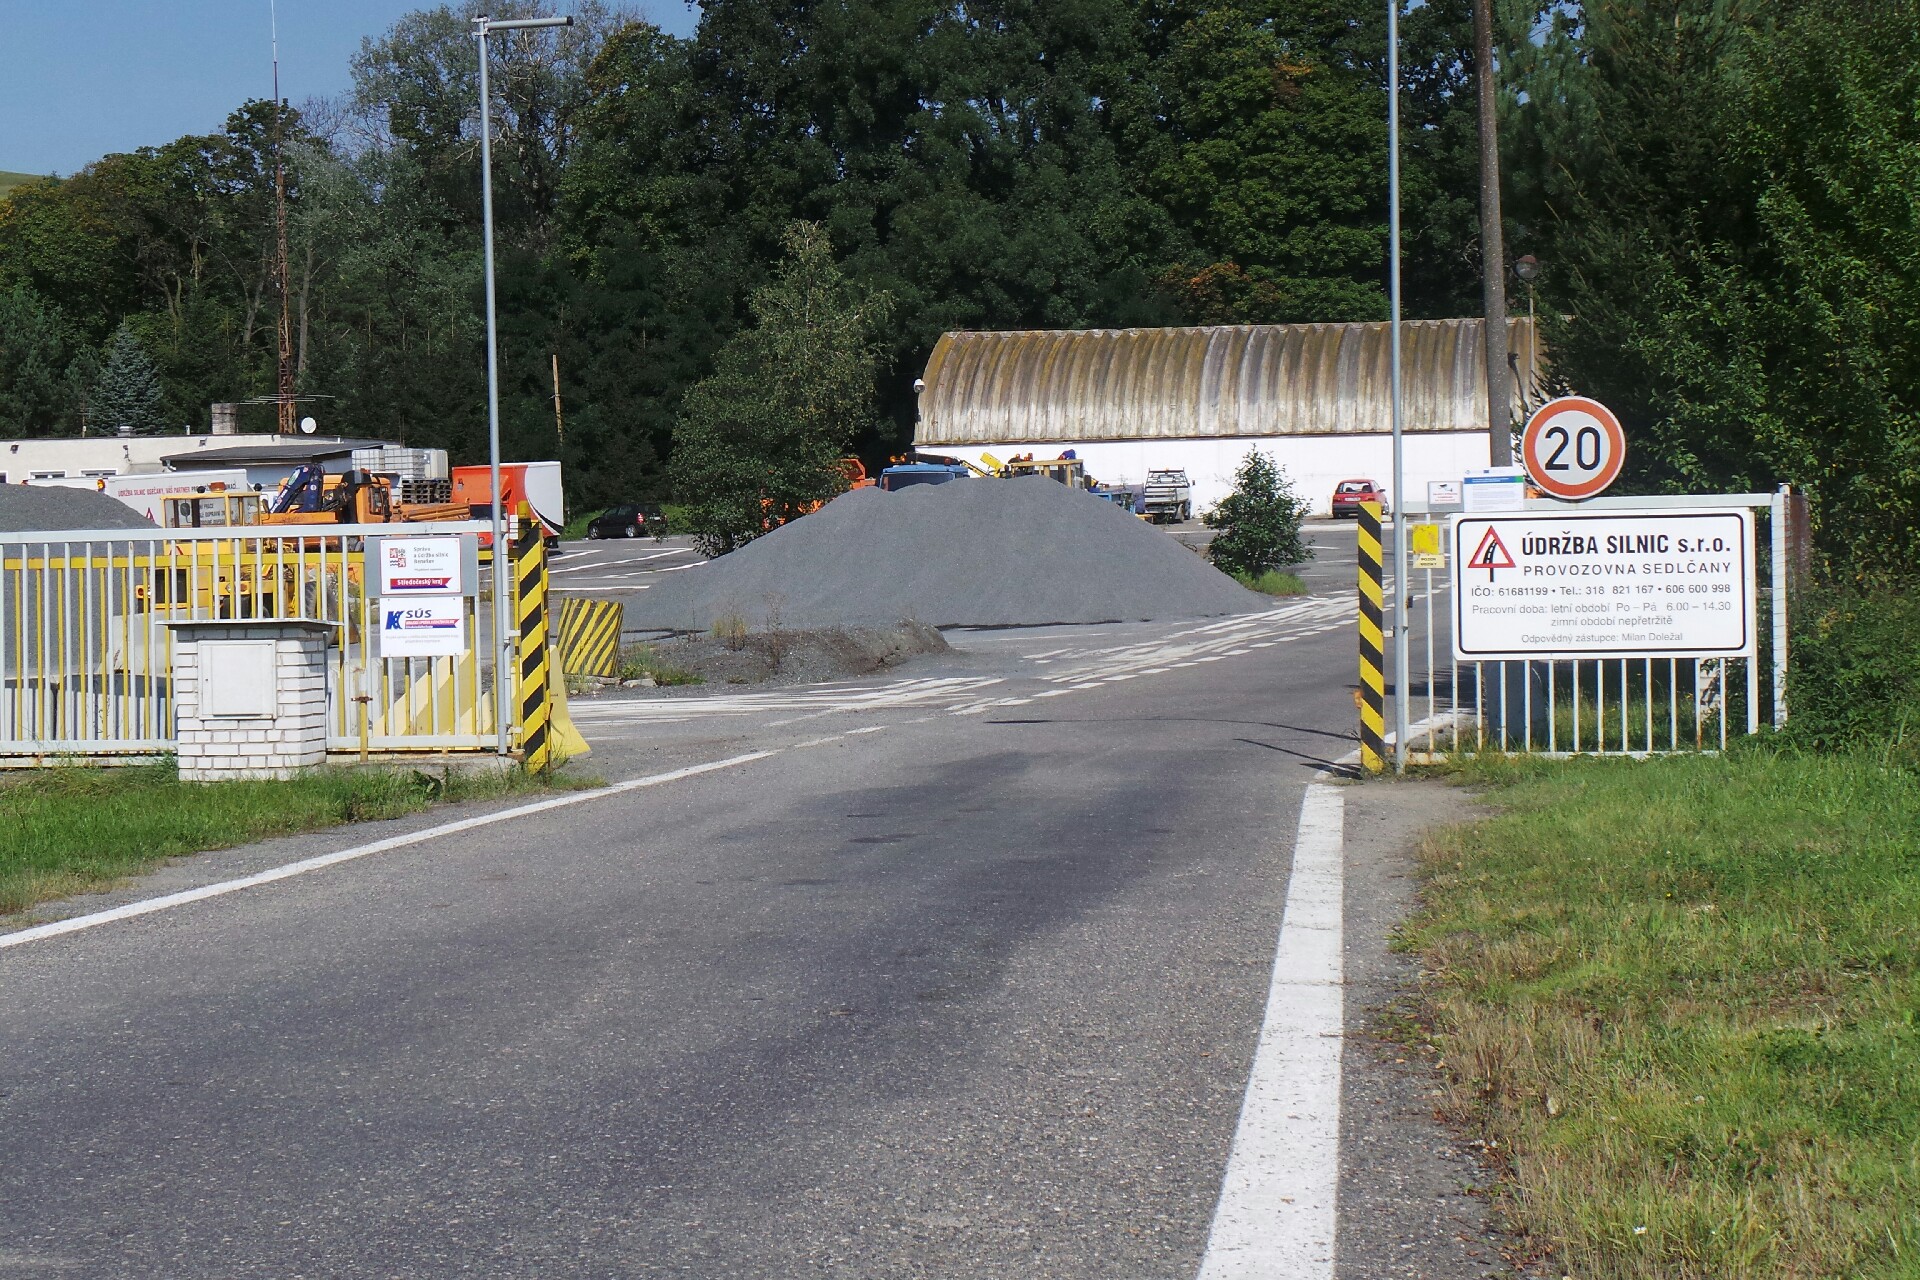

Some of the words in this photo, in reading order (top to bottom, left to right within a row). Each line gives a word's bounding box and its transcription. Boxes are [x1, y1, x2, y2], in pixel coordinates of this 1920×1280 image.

[1544, 426, 1601, 471] 20
[1522, 531, 1598, 555] ÚDRŽBA
[1607, 535, 1669, 554] SILNIC
[1678, 538, 1731, 553] s.r.o.
[1524, 564, 1637, 577] PROVOZOVNA
[1643, 560, 1731, 575] SEDLČANY
[1471, 584, 1495, 597] IČO:
[1498, 587, 1549, 597] 61681199
[1560, 586, 1582, 596] Tel.:
[1612, 586, 1630, 595] 821
[1635, 585, 1654, 594] 167
[1666, 585, 1685, 593] 606
[1689, 584, 1708, 593] 600
[1712, 584, 1731, 593] 998
[406, 607, 432, 619] SÚS
[1472, 604, 1517, 615] Pracovní
[1519, 604, 1548, 615] doba:
[1551, 604, 1573, 614] letní
[1575, 603, 1611, 614] období
[1616, 603, 1631, 613] Po
[1643, 601, 1658, 612] Pá
[1667, 602, 1690, 612] 6.00
[1703, 601, 1731, 612] 14.30
[1551, 617, 1579, 627] zimní
[1581, 616, 1616, 626] období
[1618, 615, 1673, 628] nepřetržitě
[1521, 633, 1574, 645] Odpovědný
[1576, 633, 1619, 644] zástupce:
[1622, 633, 1646, 642] Milan
[1649, 632, 1683, 642] Doležal
